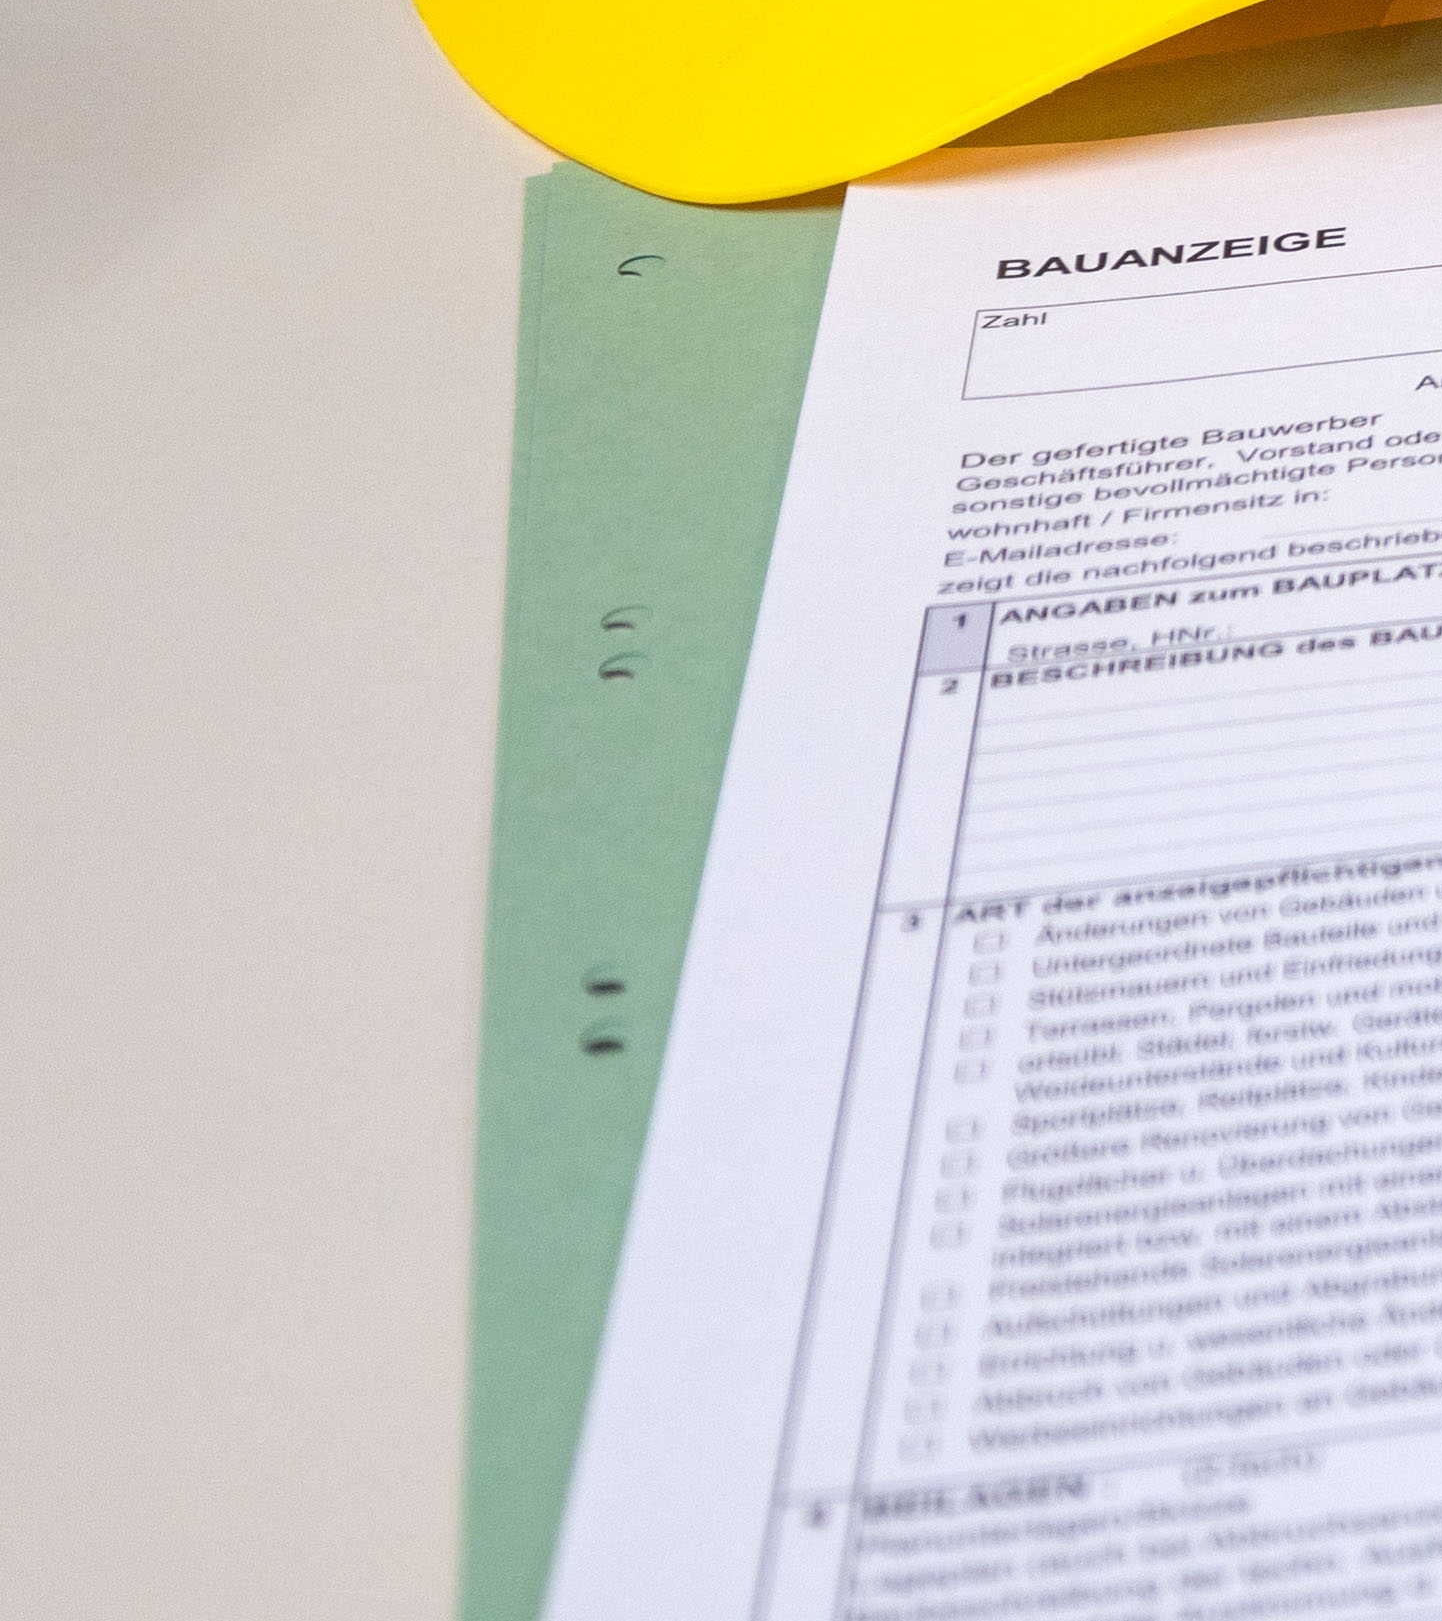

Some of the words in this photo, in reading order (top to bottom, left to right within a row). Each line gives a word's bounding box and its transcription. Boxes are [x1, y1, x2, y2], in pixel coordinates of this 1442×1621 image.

[996, 227, 1346, 279] BAUANZEIGE
[980, 311, 1047, 329] Zahl
[960, 452, 1022, 468] Der
[1032, 436, 1188, 466] gefertigte
[1201, 413, 1382, 445] Bauwerber
[1236, 434, 1373, 462] Vorstand
[951, 492, 1082, 514] sonstige
[1093, 463, 1335, 501] bevollmächtigte
[947, 513, 1091, 540] wohnhaft
[1100, 510, 1112, 526] /
[1122, 494, 1282, 524] Firmensitz
[937, 573, 1014, 594] zeigt
[1024, 569, 1071, 586] die
[1082, 544, 1277, 580] nachfolgend
[943, 533, 1178, 567] E-Mailadresse:
[953, 612, 966, 629] 1
[999, 590, 1177, 624] ANGABEN
[1189, 585, 1259, 604] zum
[940, 677, 959, 695] 2
[989, 639, 1284, 689] BESCHREIBUNG
[1296, 635, 1356, 654] des
